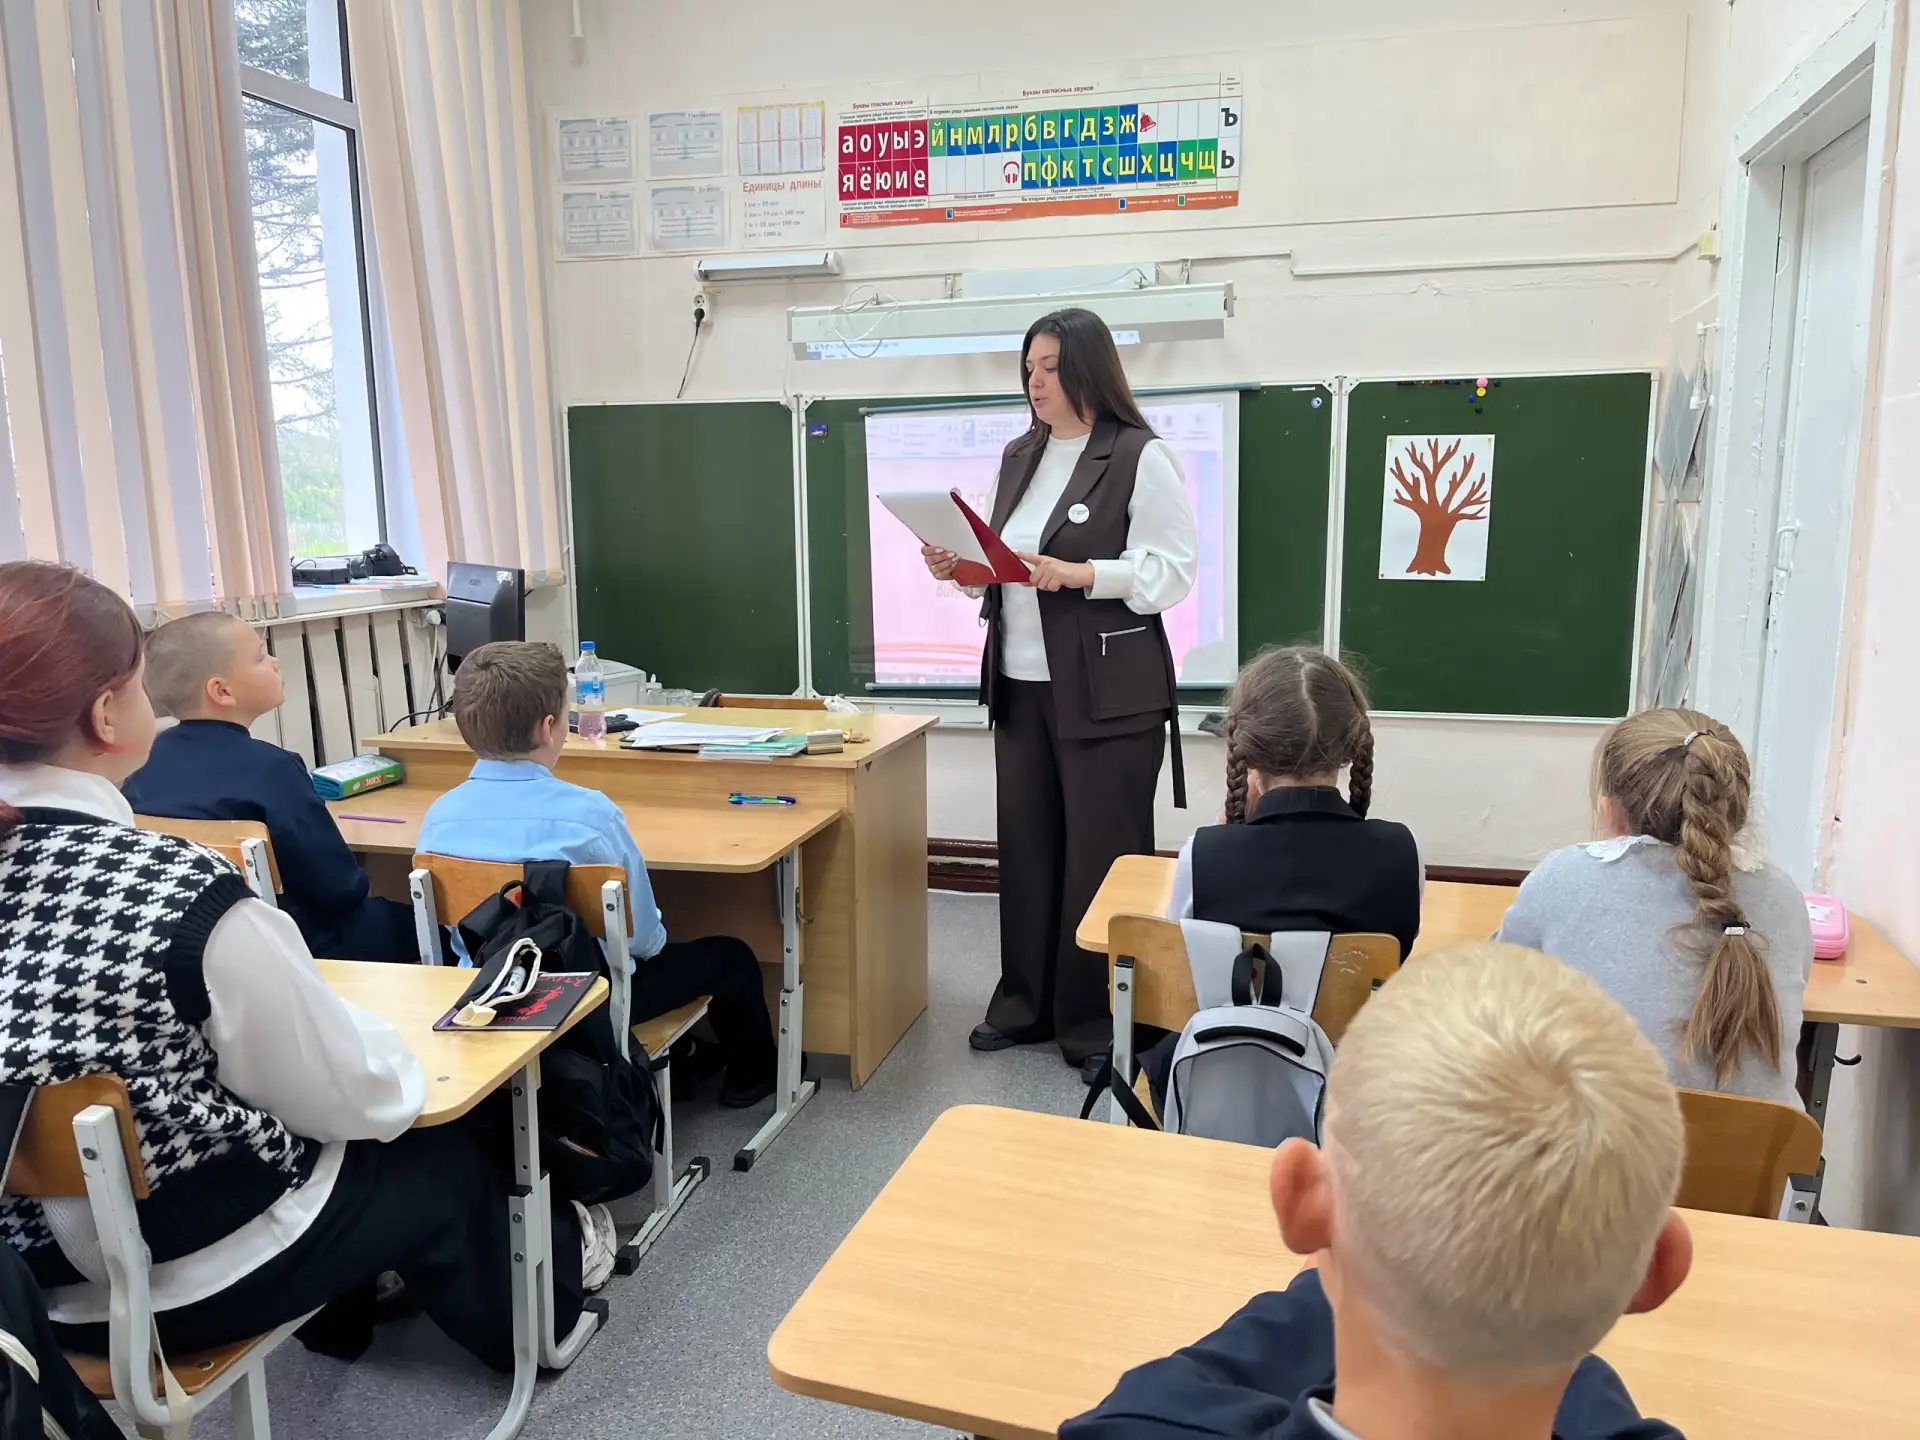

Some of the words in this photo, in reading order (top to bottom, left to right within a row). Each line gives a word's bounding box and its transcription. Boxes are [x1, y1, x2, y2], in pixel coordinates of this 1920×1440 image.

[1042, 87, 1072, 95] согласных
[1074, 85, 1094, 93] звуков
[743, 182, 785, 193] Единицы
[790, 180, 821, 192] длины
